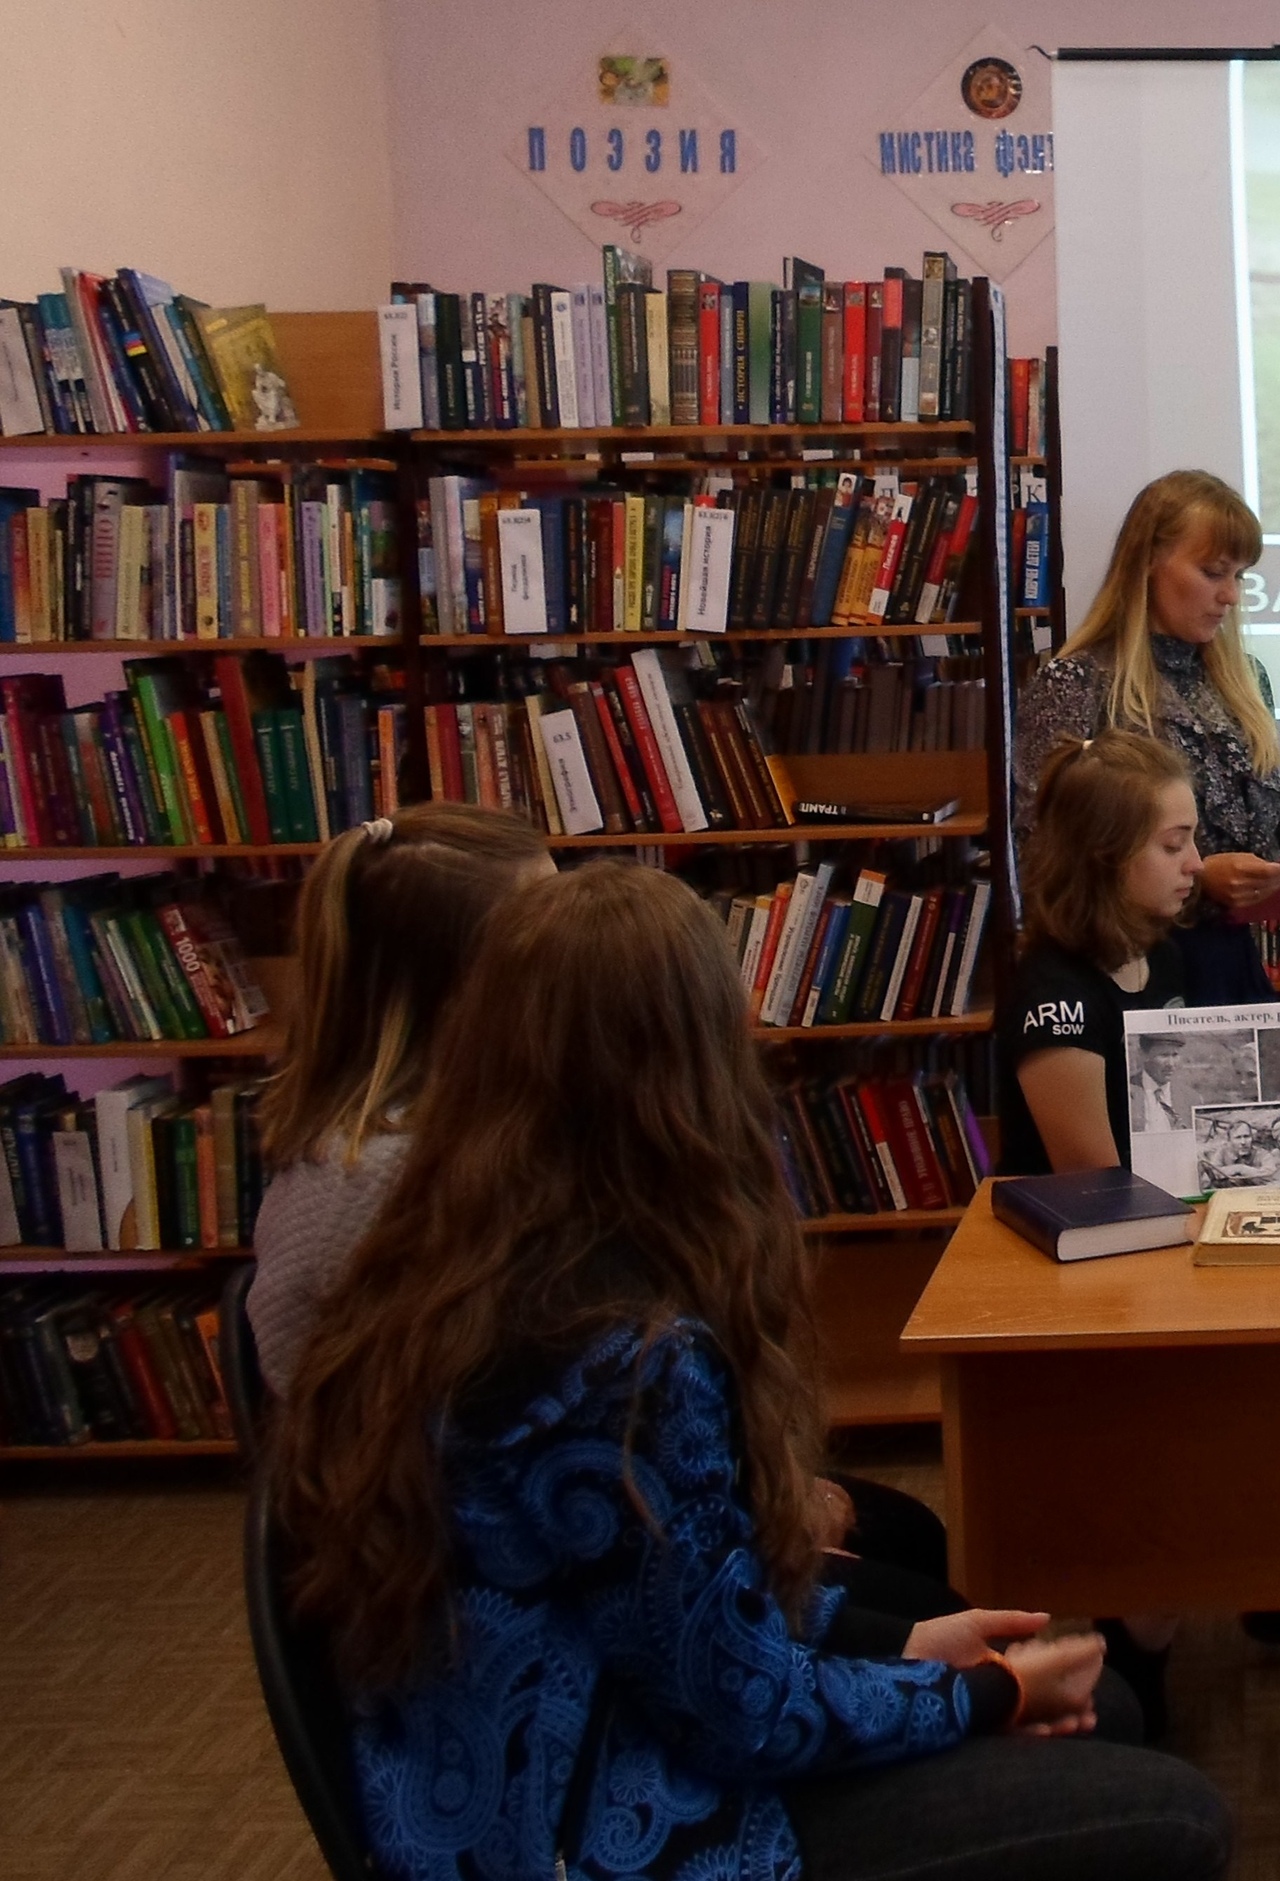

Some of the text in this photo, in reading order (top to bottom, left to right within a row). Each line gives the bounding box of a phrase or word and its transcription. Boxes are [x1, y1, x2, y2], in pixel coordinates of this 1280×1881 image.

[527, 127, 736, 174] ПОЭЗИЯ
[736, 310, 746, 402] ИСТОРИЯ СИБИРИ
[696, 526, 712, 616] Новейшая история
[174, 934, 201, 974] 1000
[1022, 1000, 1084, 1035] ARM
[1052, 1023, 1085, 1036] SOW
[1167, 1012, 1231, 1027] Писатель,
[1233, 1010, 1274, 1024] актер,
